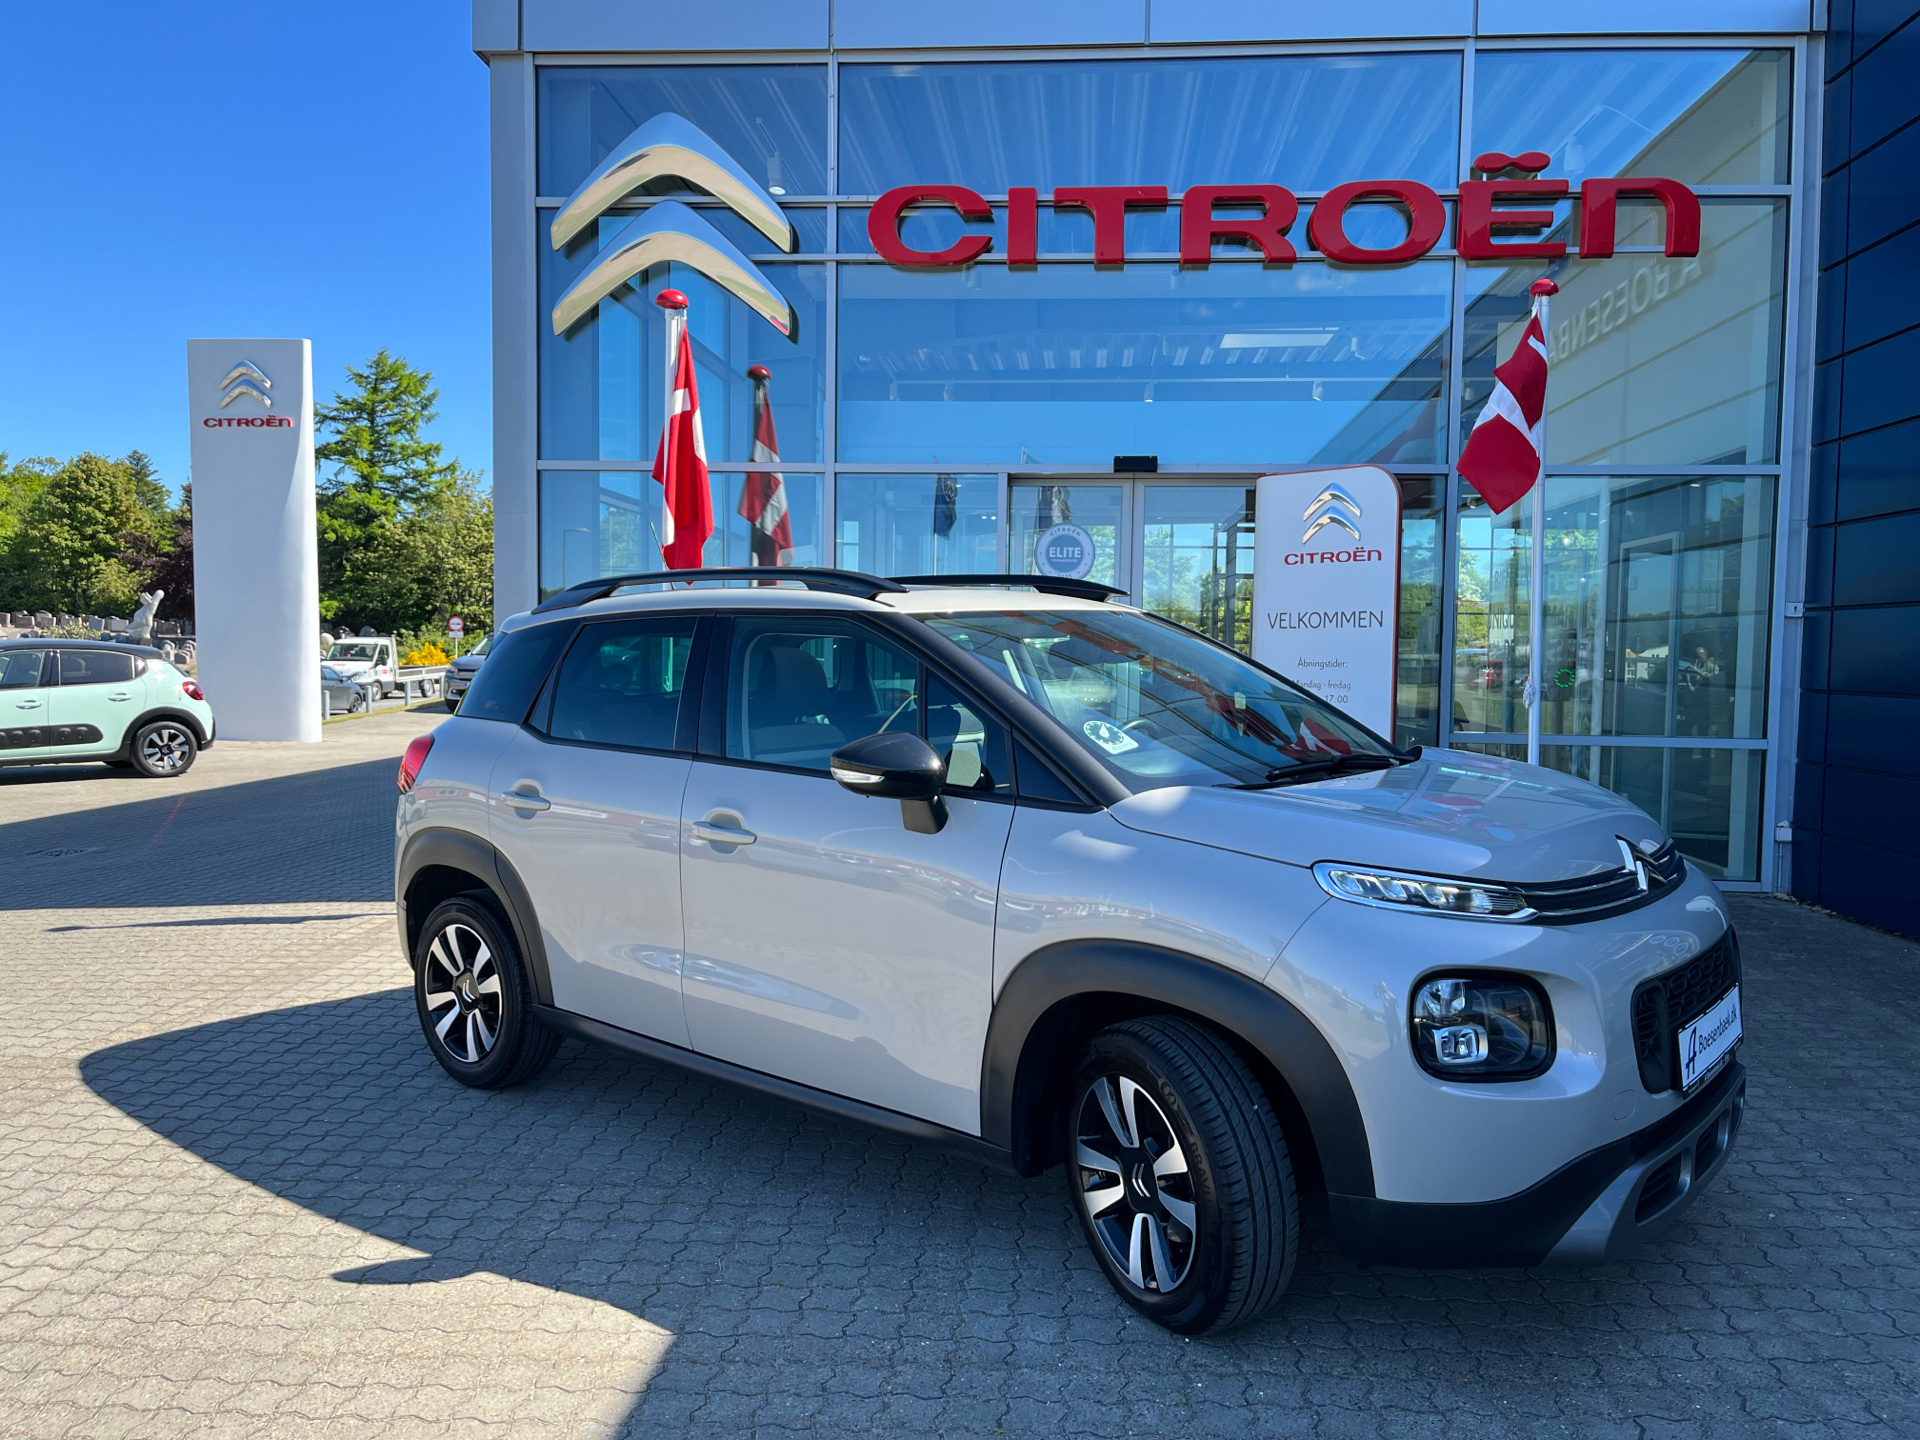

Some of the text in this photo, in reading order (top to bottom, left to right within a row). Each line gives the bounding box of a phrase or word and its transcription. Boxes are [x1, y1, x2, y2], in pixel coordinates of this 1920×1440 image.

[1049, 547, 1081, 558] ELITE
[1267, 610, 1384, 629] VELKOMMEN
[1297, 657, 1348, 670] Åbningstider:
[1328, 680, 1351, 691] fredag
[1325, 695, 1349, 704] 17:00
[1698, 1003, 1738, 1054] Boesenbaek.dk
